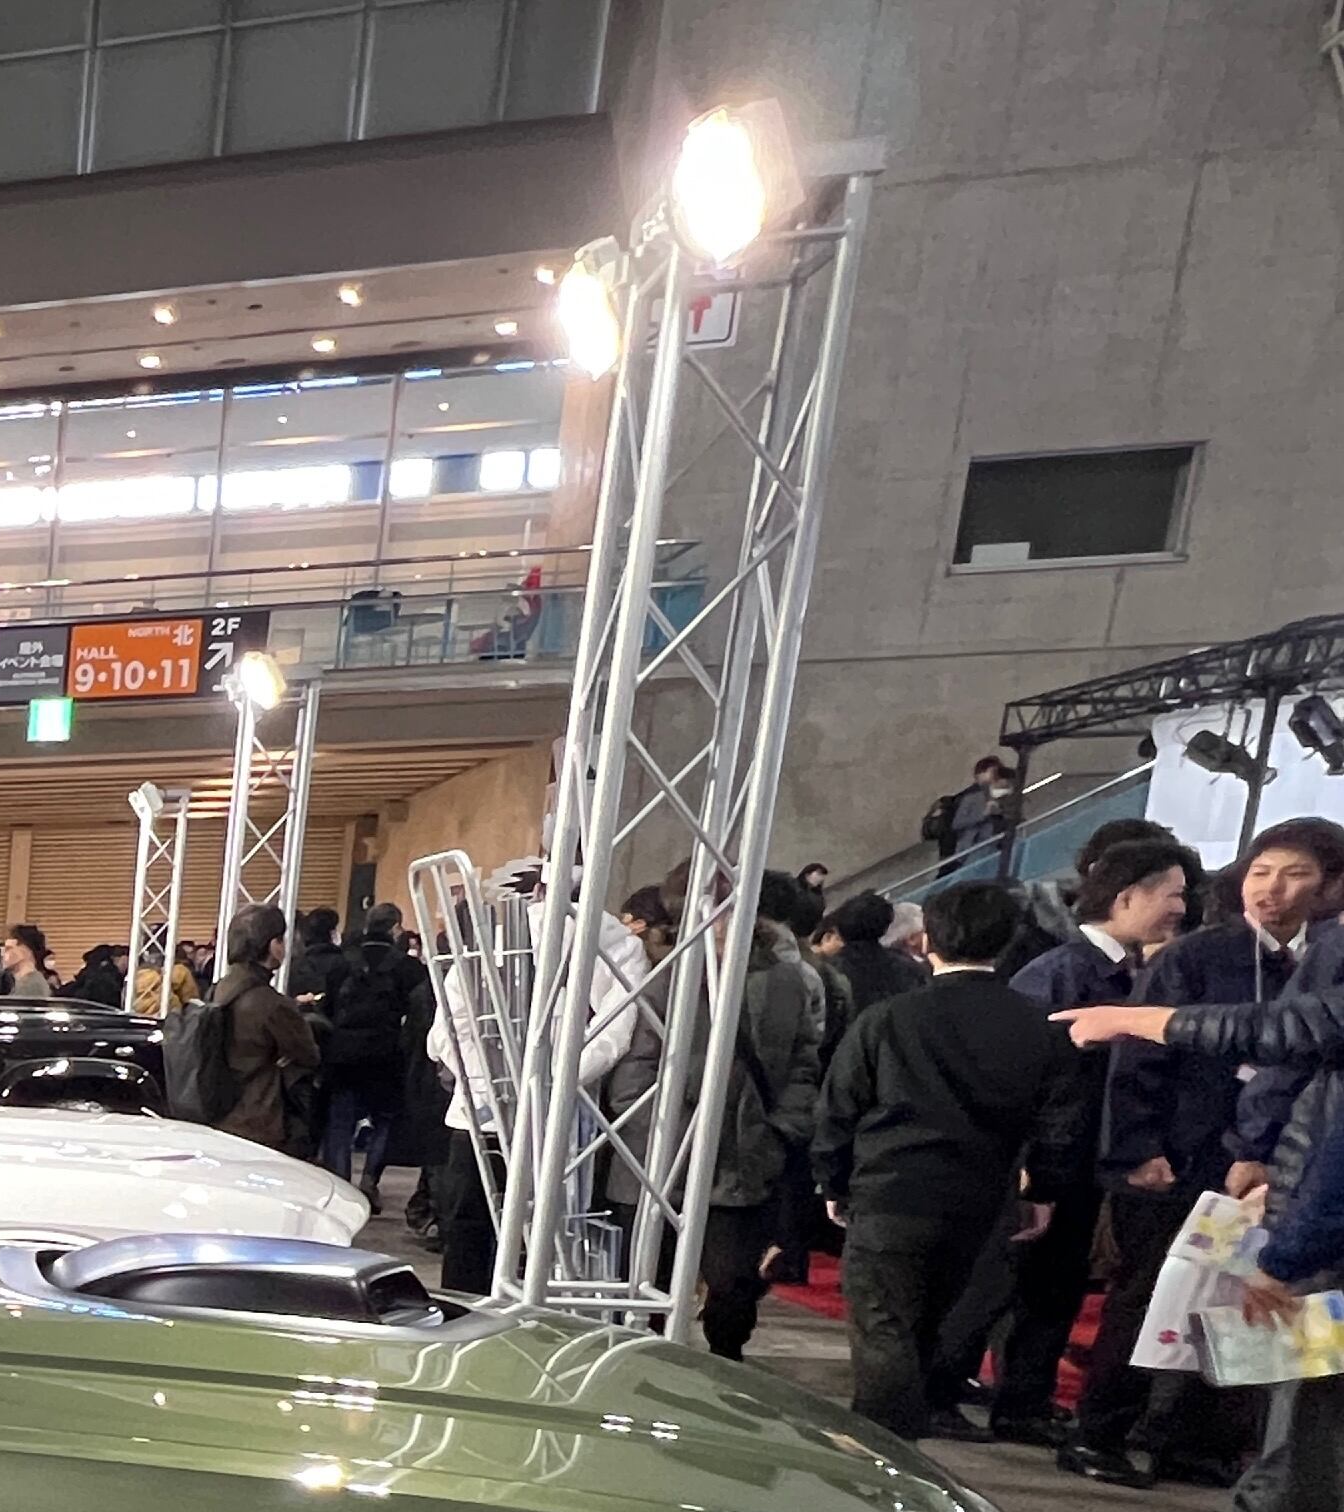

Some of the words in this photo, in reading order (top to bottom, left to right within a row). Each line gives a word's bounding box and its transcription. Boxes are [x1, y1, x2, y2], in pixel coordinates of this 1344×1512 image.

[128, 626, 171, 639] NORTH
[172, 624, 194, 647] 北
[211, 617, 242, 636] 2F
[75, 646, 119, 661] HALL
